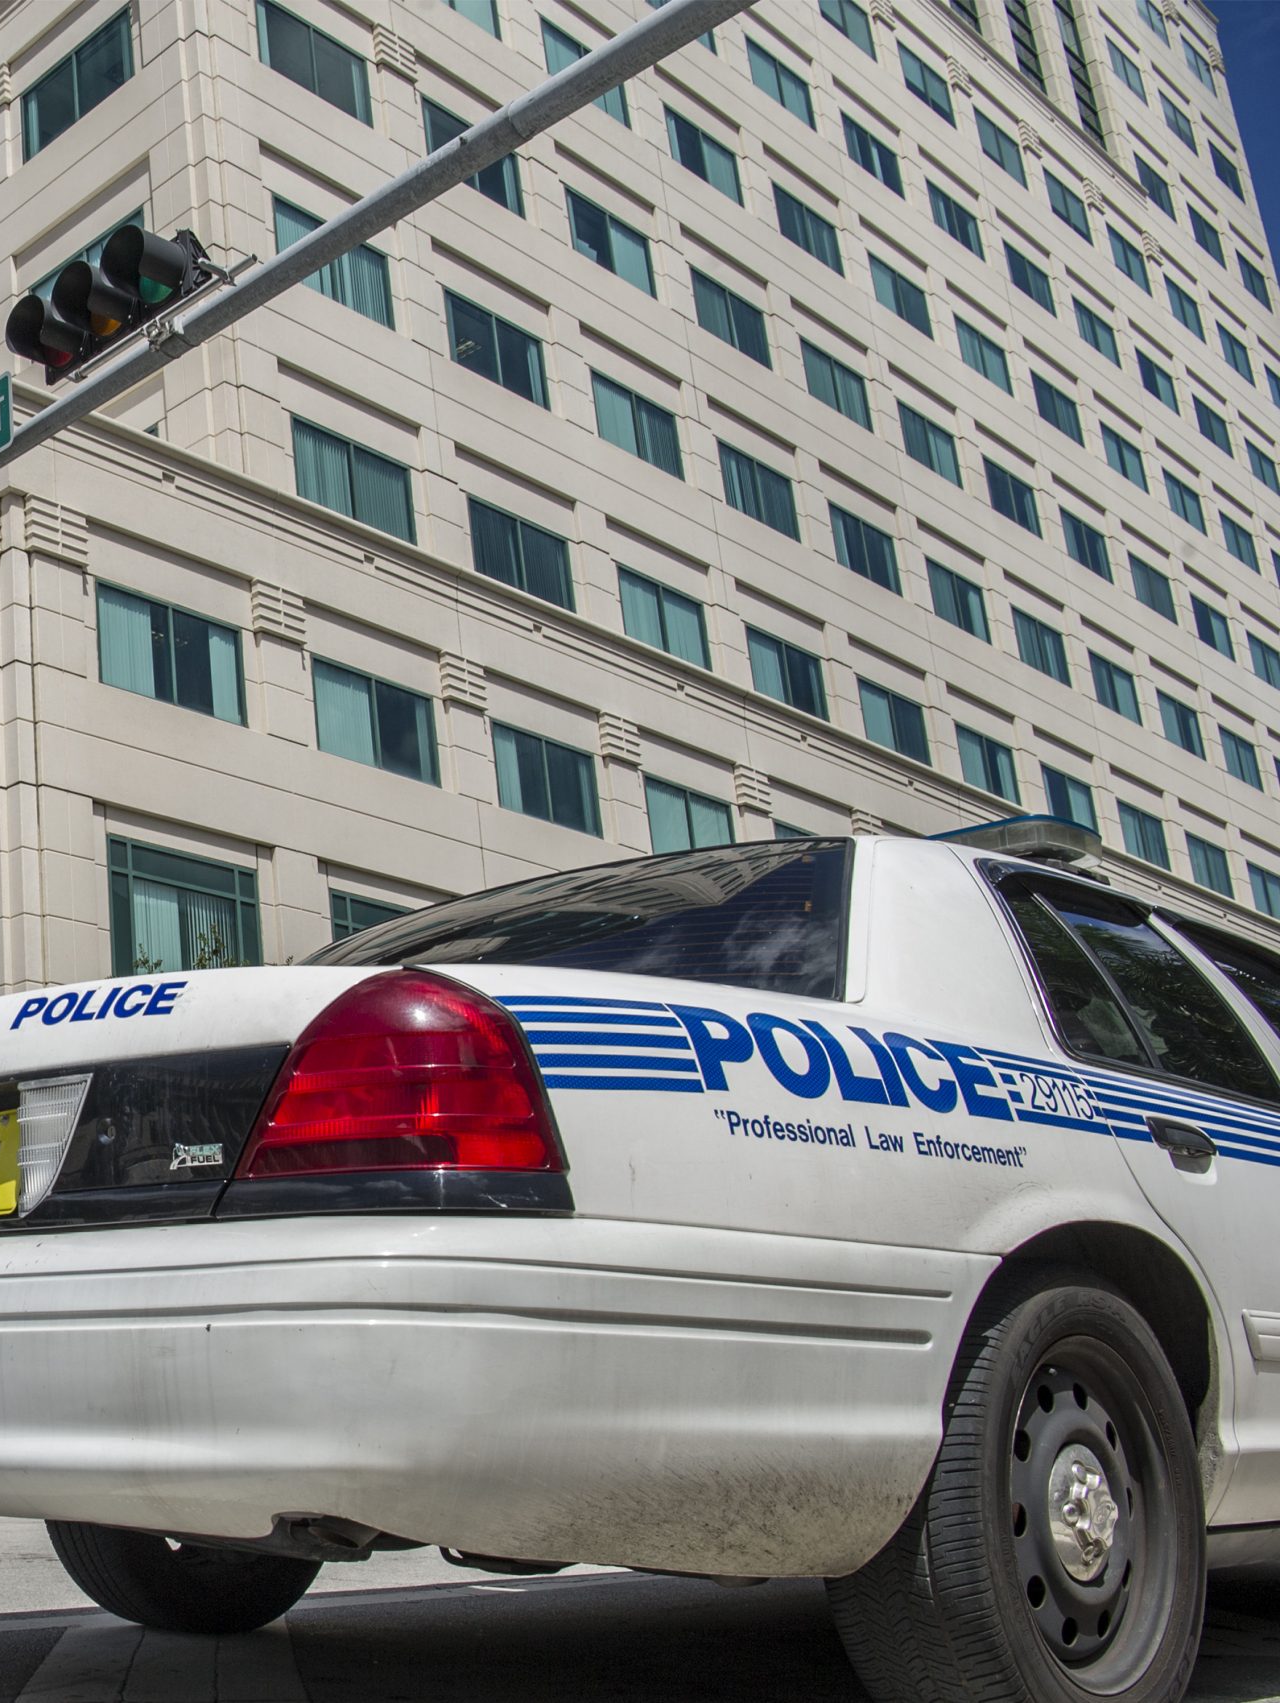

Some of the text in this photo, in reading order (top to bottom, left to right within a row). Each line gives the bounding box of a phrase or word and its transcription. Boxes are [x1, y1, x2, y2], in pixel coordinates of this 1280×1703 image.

[10, 980, 189, 1031] POLICE
[665, 1003, 1096, 1123] POLICE 29115
[190, 1154, 220, 1164] FUEL
[864, 1125, 905, 1154] Law
